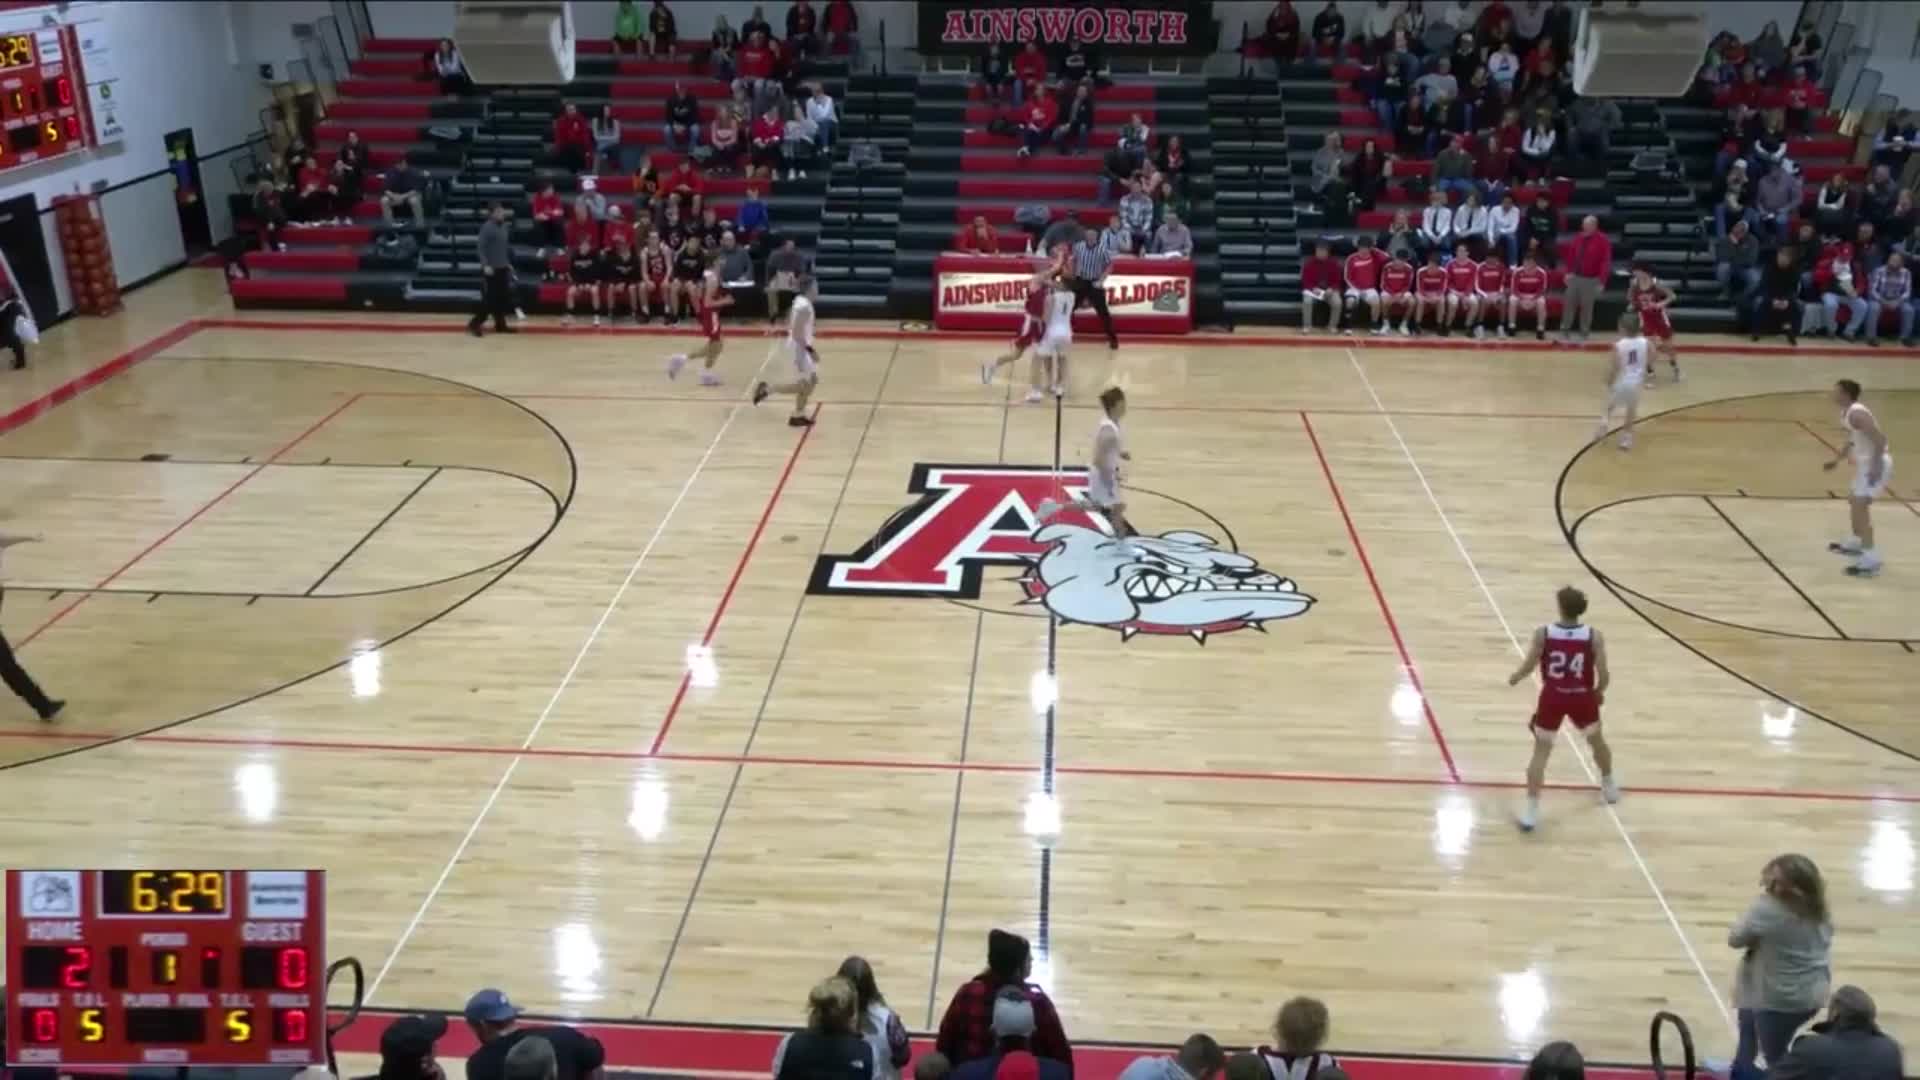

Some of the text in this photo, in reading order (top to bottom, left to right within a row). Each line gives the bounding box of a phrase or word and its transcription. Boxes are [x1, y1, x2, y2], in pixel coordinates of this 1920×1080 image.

[942, 8, 1188, 43] AINSWORTH
[1107, 279, 1187, 305] LLDOGS
[806, 462, 1138, 599] A
[1549, 651, 1585, 678] 24
